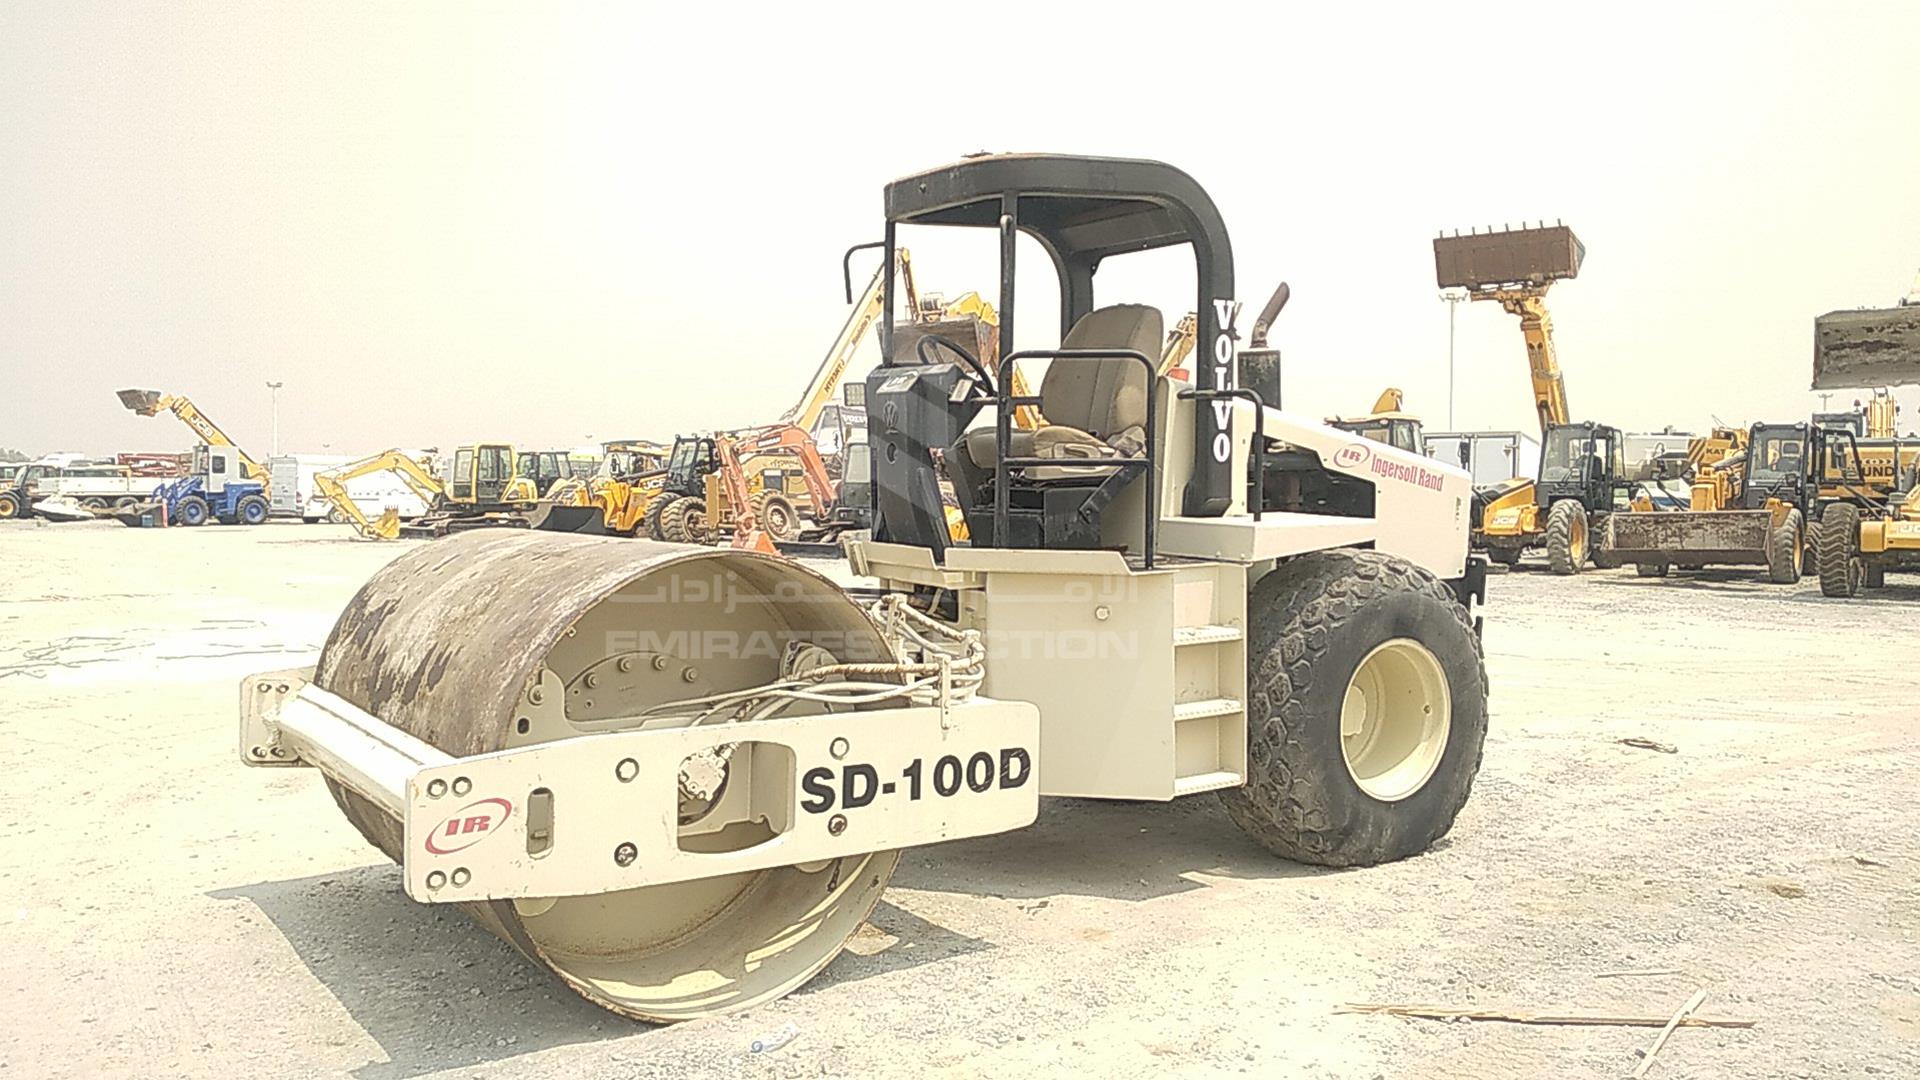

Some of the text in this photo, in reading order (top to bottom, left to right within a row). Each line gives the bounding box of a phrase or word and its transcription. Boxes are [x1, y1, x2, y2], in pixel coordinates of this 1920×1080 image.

[1211, 299, 1234, 462] VOLVO
[190, 414, 214, 438] JCB
[1342, 448, 1361, 462] IR
[1371, 453, 1444, 492] Ingersoll Rand
[800, 747, 1031, 814] SD-100D
[444, 815, 491, 836] IR
